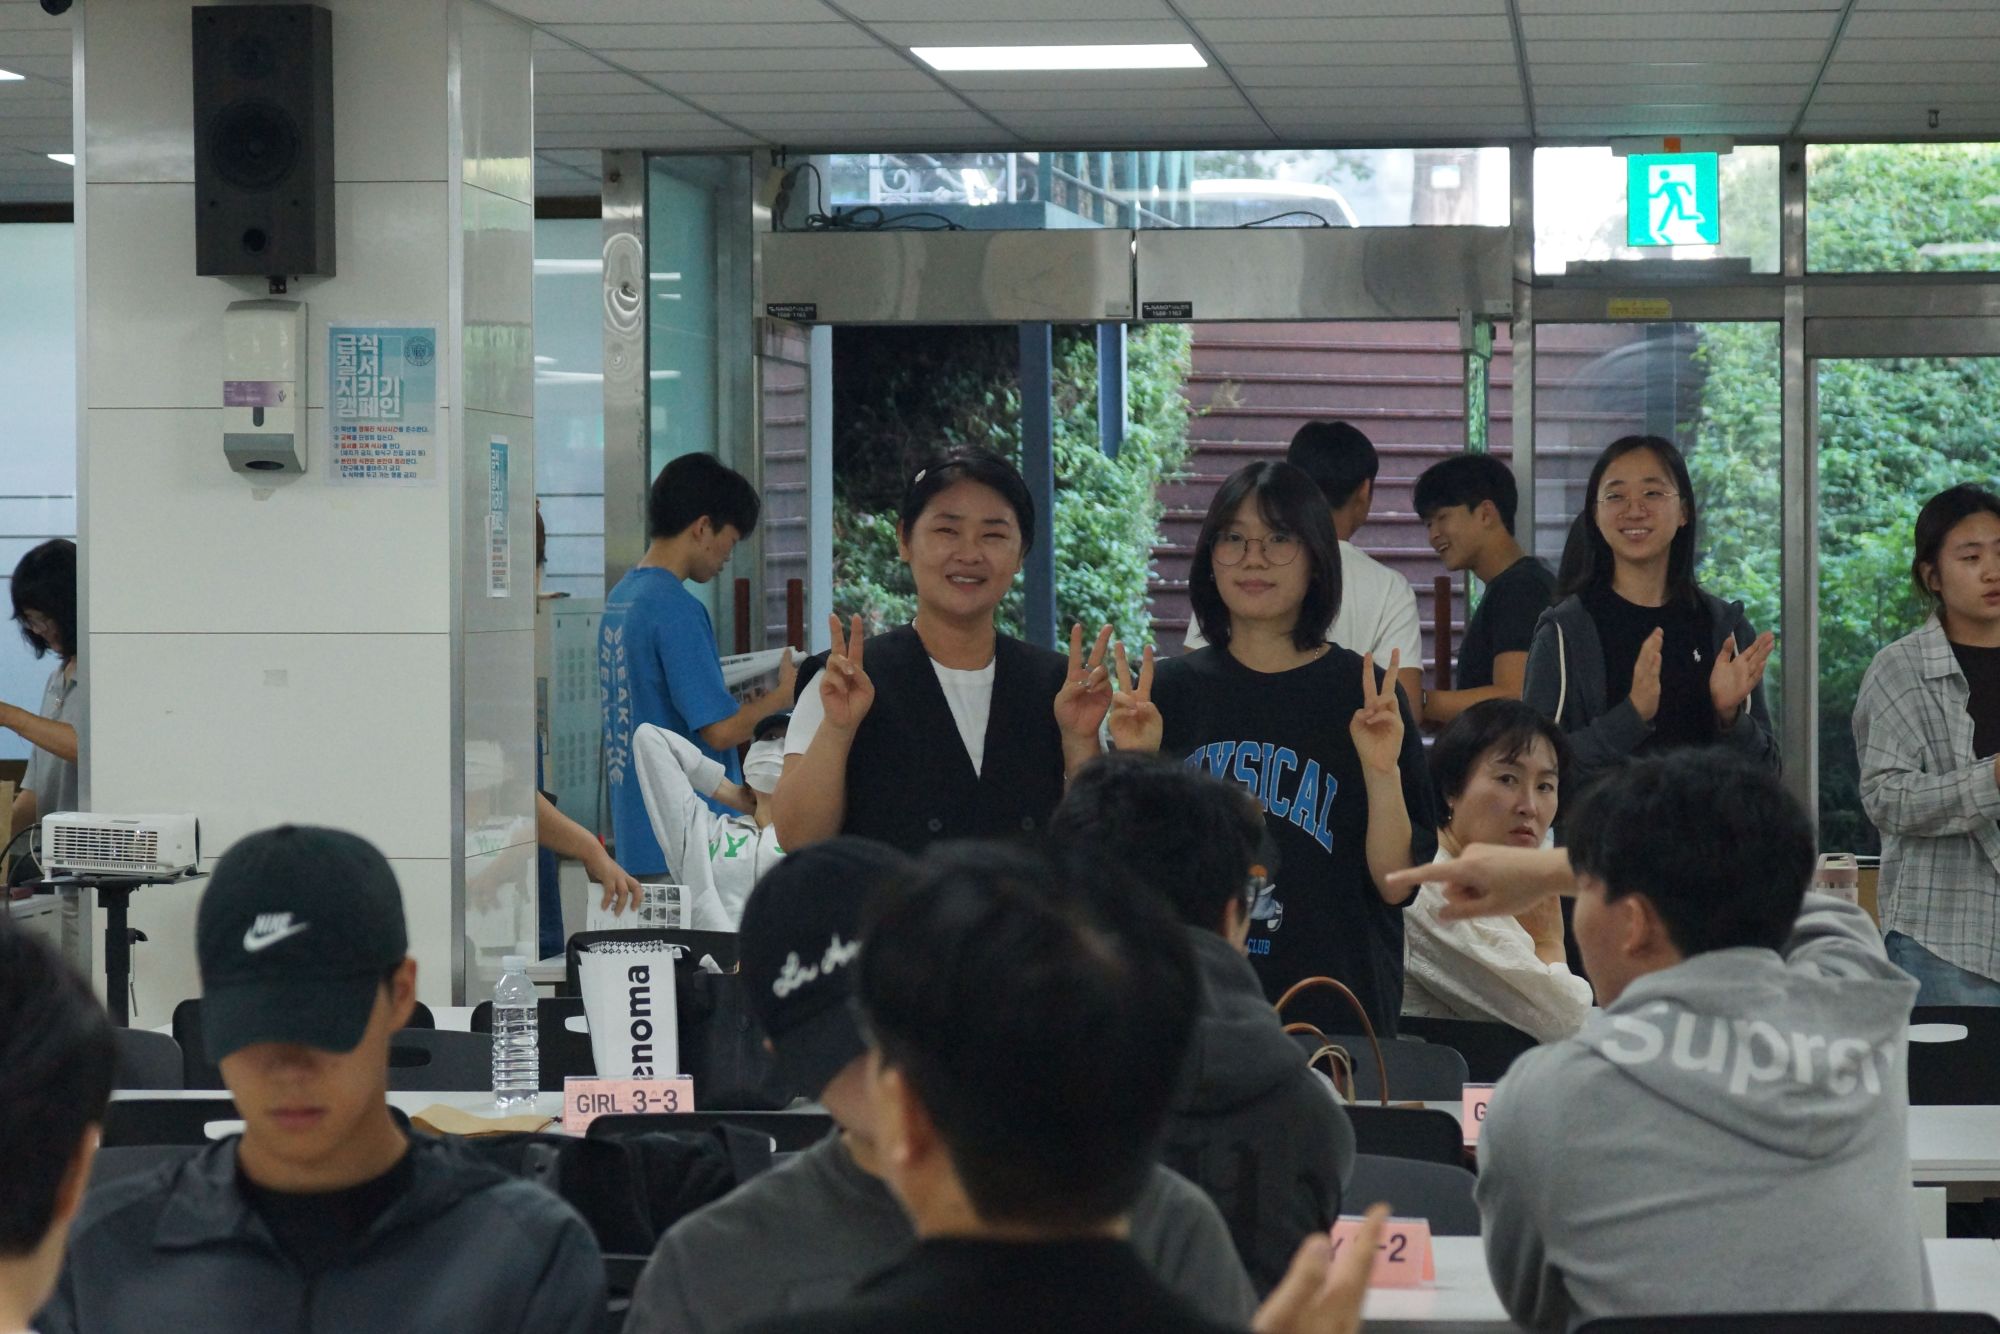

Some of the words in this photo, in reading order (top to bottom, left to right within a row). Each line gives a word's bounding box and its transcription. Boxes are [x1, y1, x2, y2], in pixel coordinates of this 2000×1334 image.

[336, 334, 378, 355] 급식
[336, 355, 378, 376] 질서
[336, 376, 400, 396] 지키기
[336, 397, 400, 418] 캠페인
[1184, 741, 1338, 853] YSICAL
[252, 912, 295, 934] NIKE
[1248, 939, 1271, 955] CLUB
[577, 1094, 622, 1113] GIRL
[632, 1089, 678, 1112] 3-3
